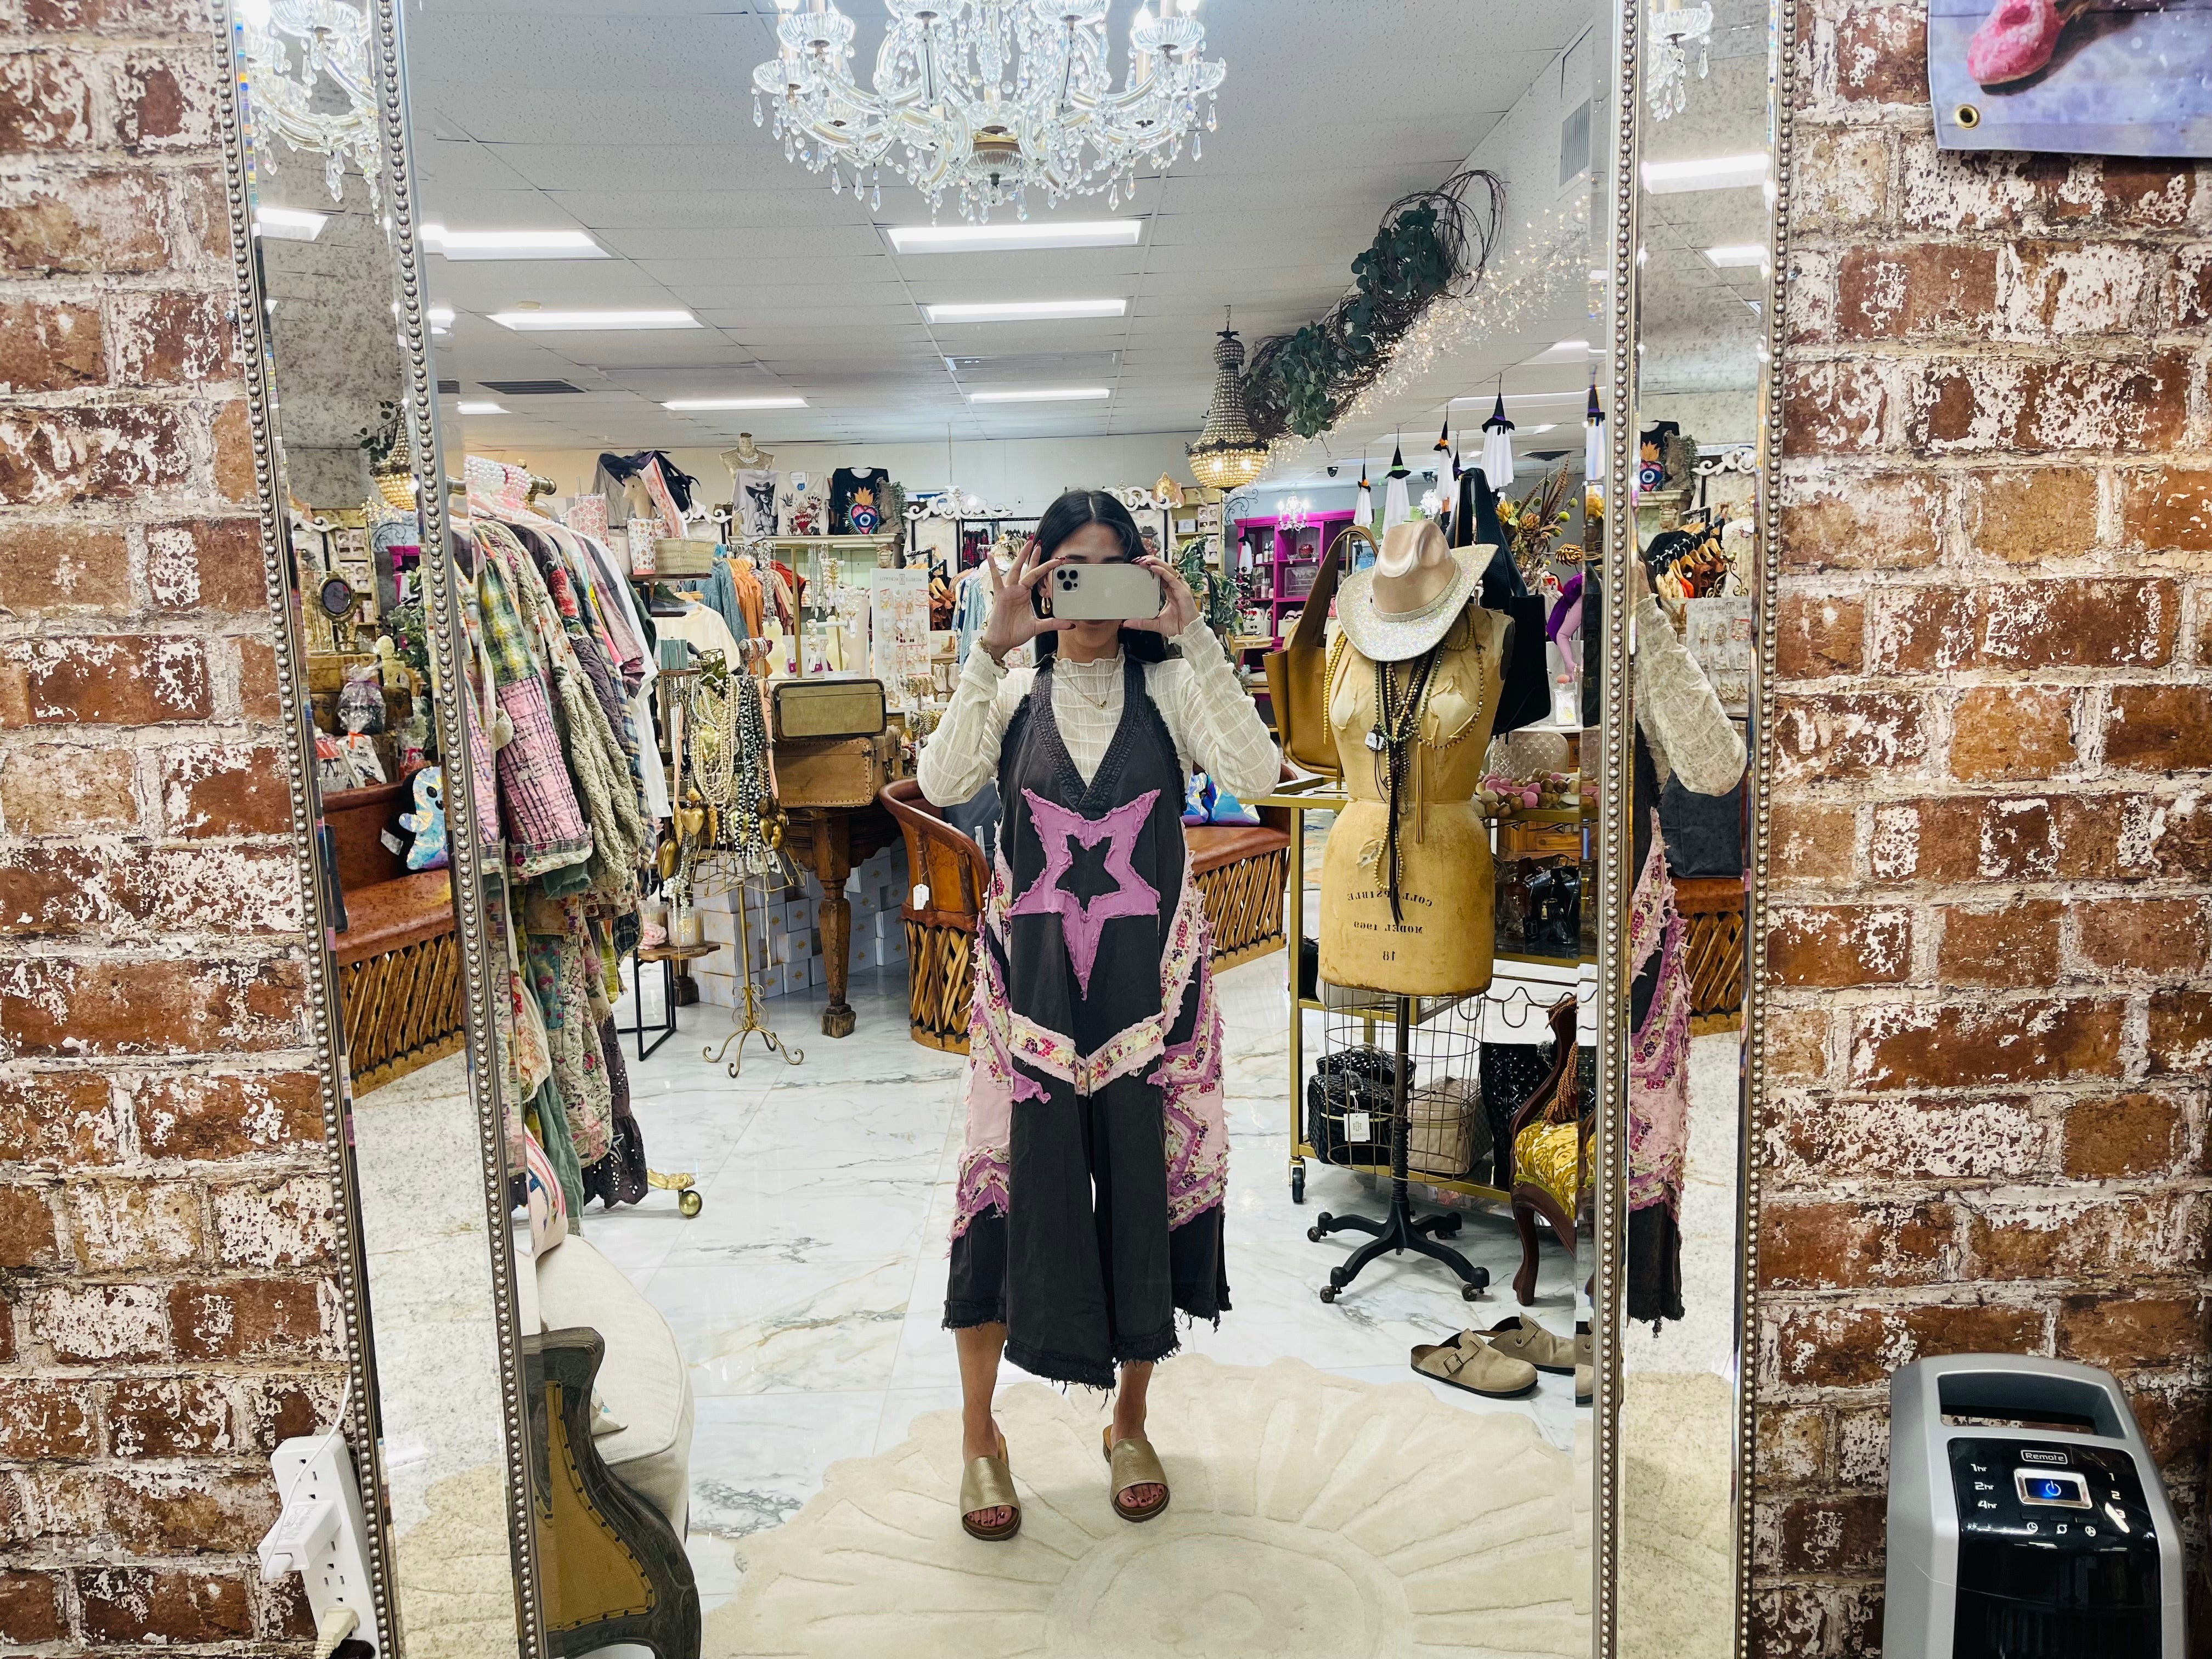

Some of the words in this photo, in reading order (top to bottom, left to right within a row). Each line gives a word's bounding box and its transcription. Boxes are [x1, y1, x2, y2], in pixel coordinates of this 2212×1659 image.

[2025, 1452, 2064, 1462] Remote
[1971, 1463, 1988, 1472] 1hr
[2108, 1472, 2115, 1481] 1
[1974, 1481, 1995, 1491] 2hr
[2111, 1490, 2121, 1500] 2
[1977, 1499, 1997, 1509] 4hr
